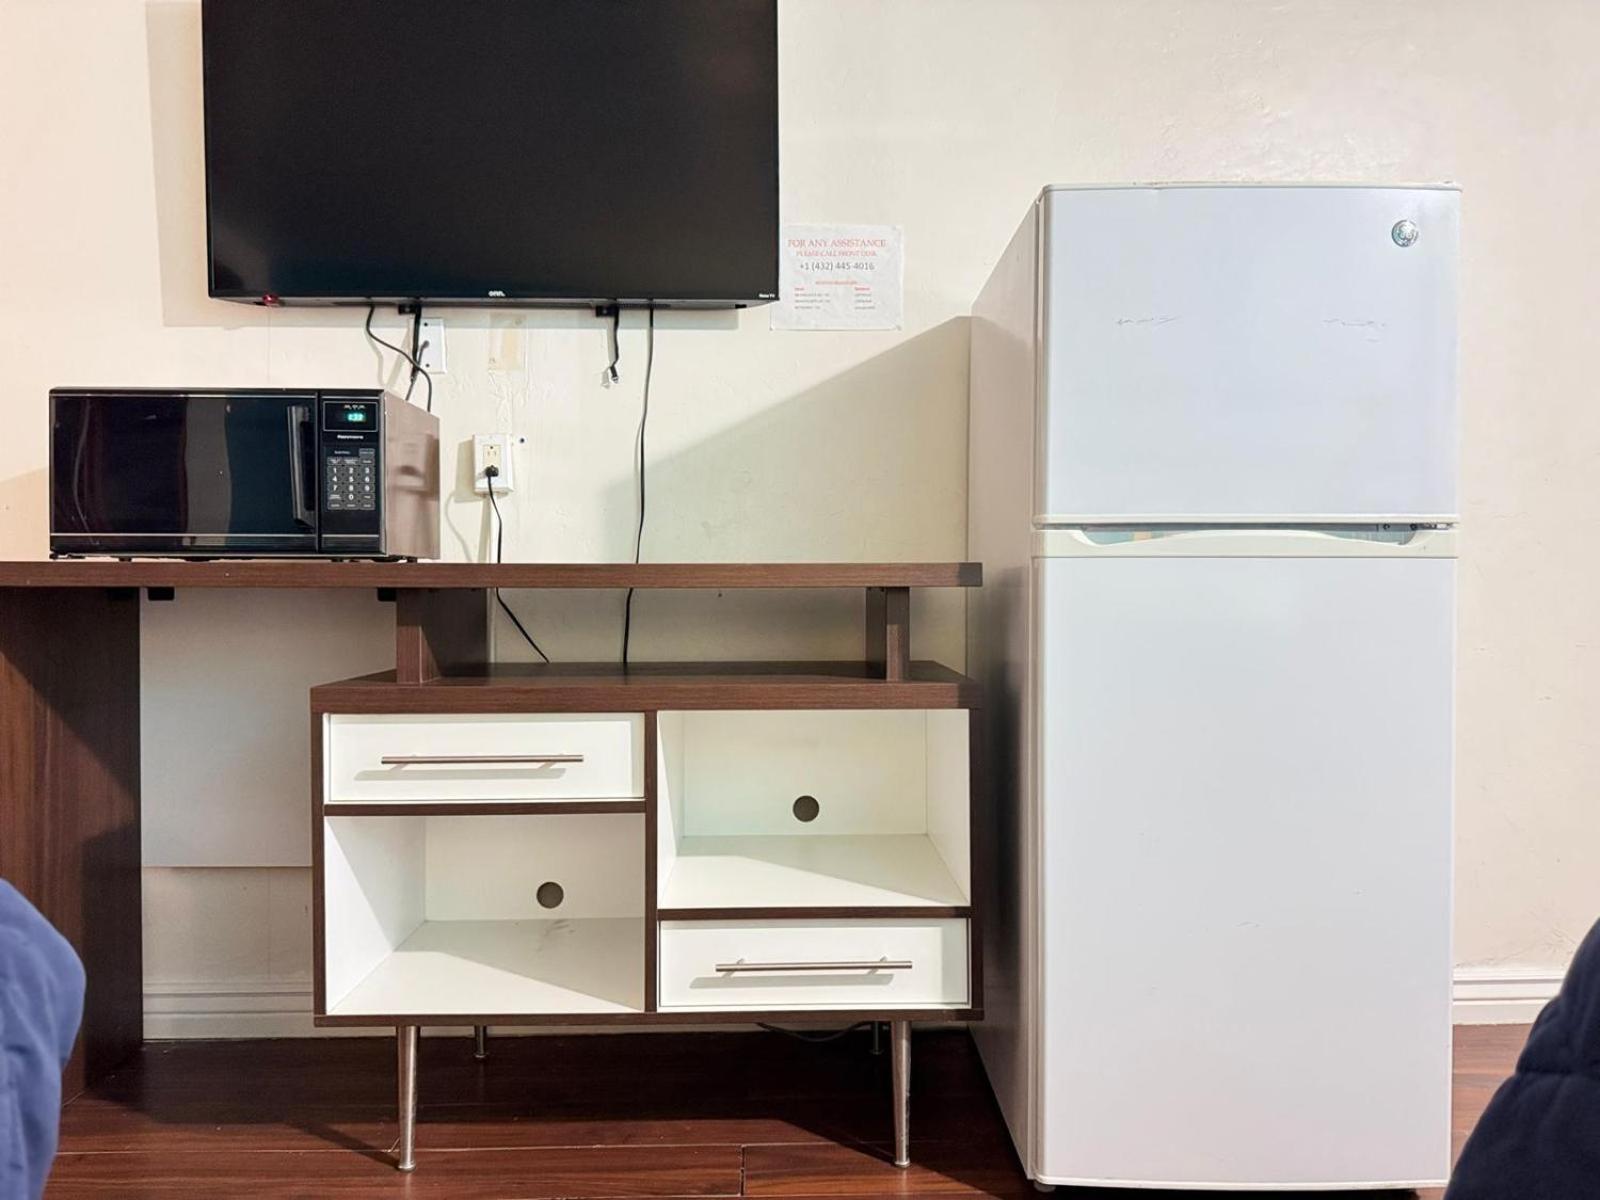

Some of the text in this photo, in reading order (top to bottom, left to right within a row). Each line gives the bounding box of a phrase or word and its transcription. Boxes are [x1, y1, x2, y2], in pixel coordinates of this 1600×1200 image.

[787, 239, 887, 248] FOR ANY ASSISTANCE
[799, 261, 875, 272] +1 (432) 445-4016
